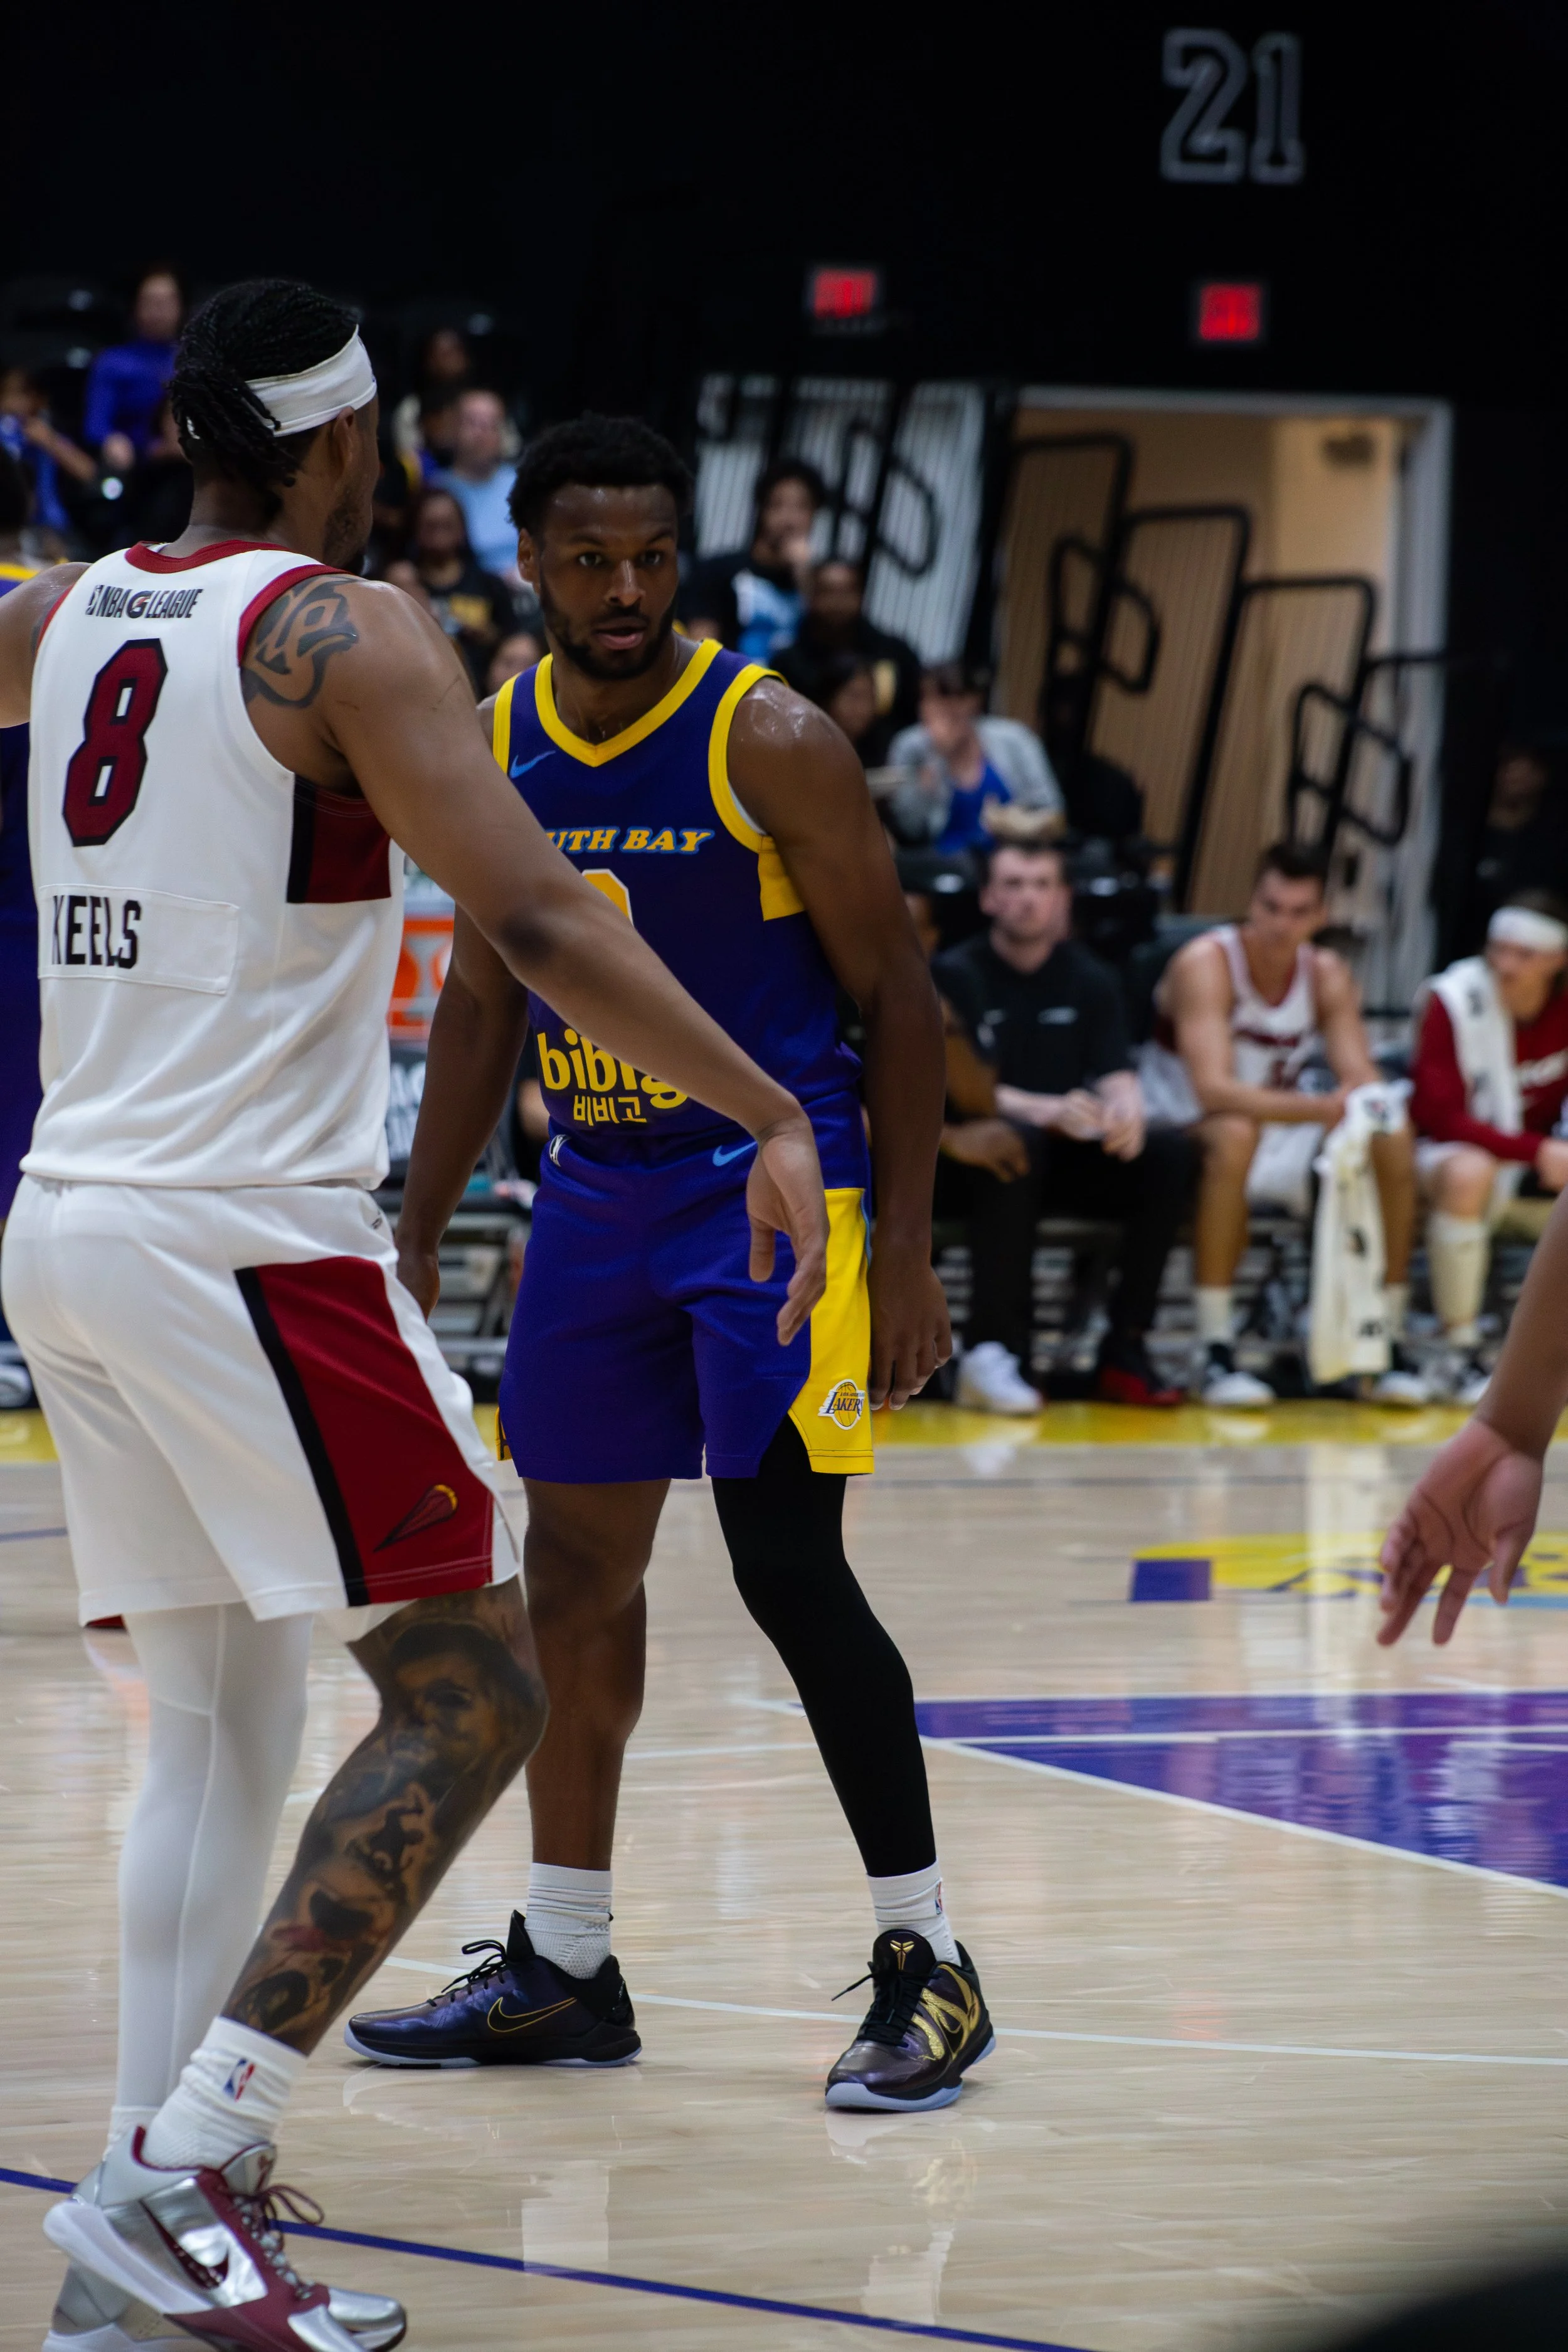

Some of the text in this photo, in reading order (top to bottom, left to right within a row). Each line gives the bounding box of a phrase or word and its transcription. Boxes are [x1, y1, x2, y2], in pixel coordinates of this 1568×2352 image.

[1160, 28, 1305, 184] 21
[144, 588, 204, 618] LEAGUE
[61, 638, 168, 847] 8
[544, 825, 715, 854] UTH BAY
[51, 895, 141, 969] KEELS
[537, 1027, 689, 1110] bibig
[573, 1094, 648, 1126] 비비고
